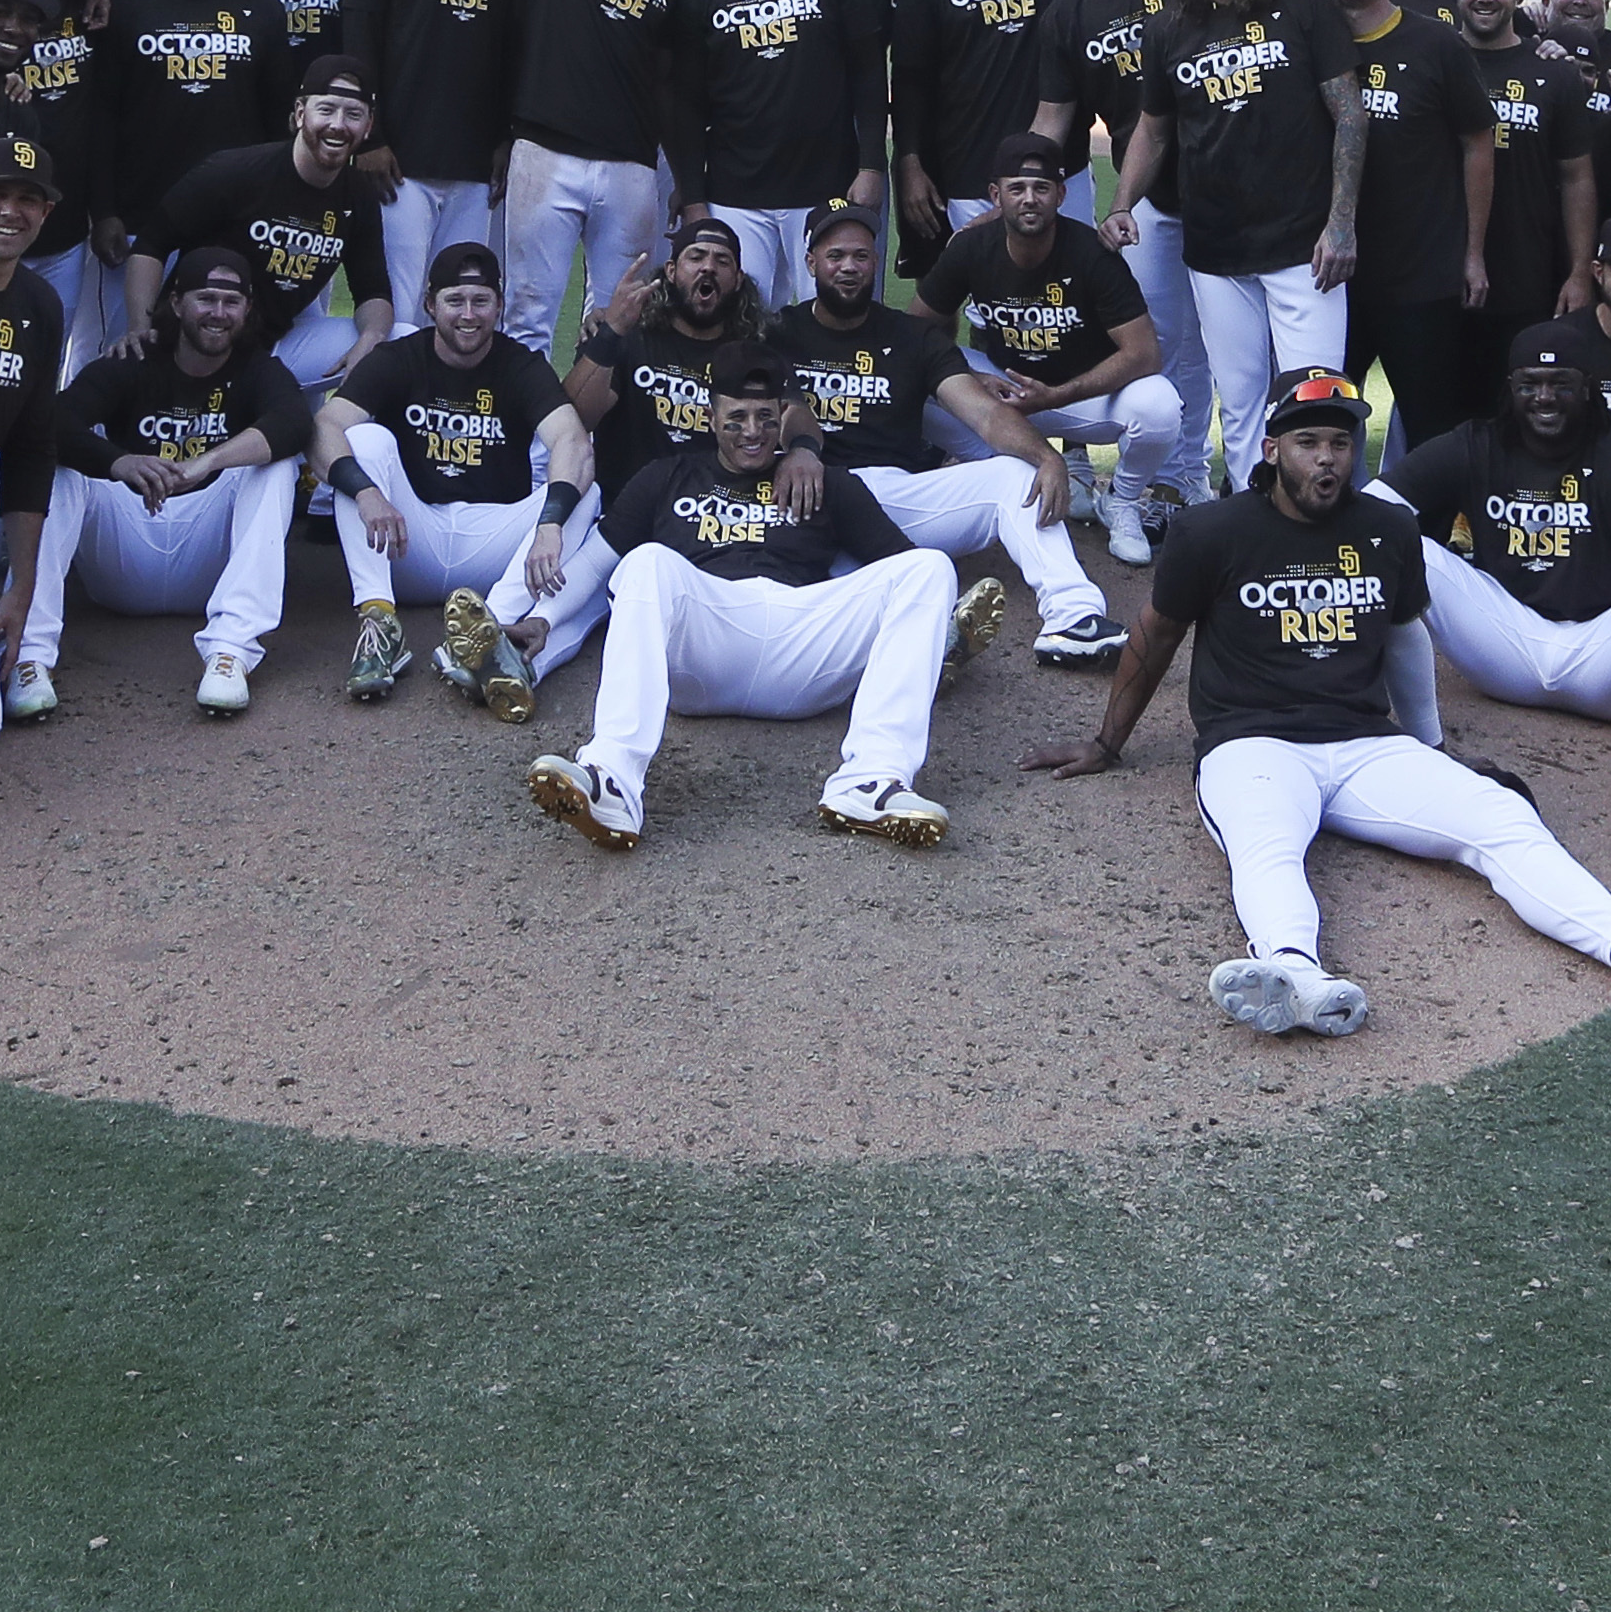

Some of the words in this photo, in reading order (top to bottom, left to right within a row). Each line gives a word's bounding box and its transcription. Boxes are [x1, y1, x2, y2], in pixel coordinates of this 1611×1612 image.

[138, 34, 251, 55] OCTOBER
[740, 18, 799, 50] RISE
[25, 59, 80, 89] RISE
[167, 55, 227, 80] RISE
[1177, 41, 1288, 83] OCTOBER
[1206, 67, 1263, 103] RISE
[250, 221, 344, 258] OCTOBER
[267, 248, 319, 280] RISE
[978, 303, 1083, 328] OCTOBER
[1002, 327, 1062, 352] RISE
[139, 413, 228, 439] OCTOBER
[406, 404, 504, 438] OCTOBER
[426, 438, 483, 465] RISE
[698, 514, 765, 542] RISE
[1507, 527, 1570, 557] RISE
[1240, 577, 1384, 608] OCTOBER
[1281, 608, 1357, 642] RISE
